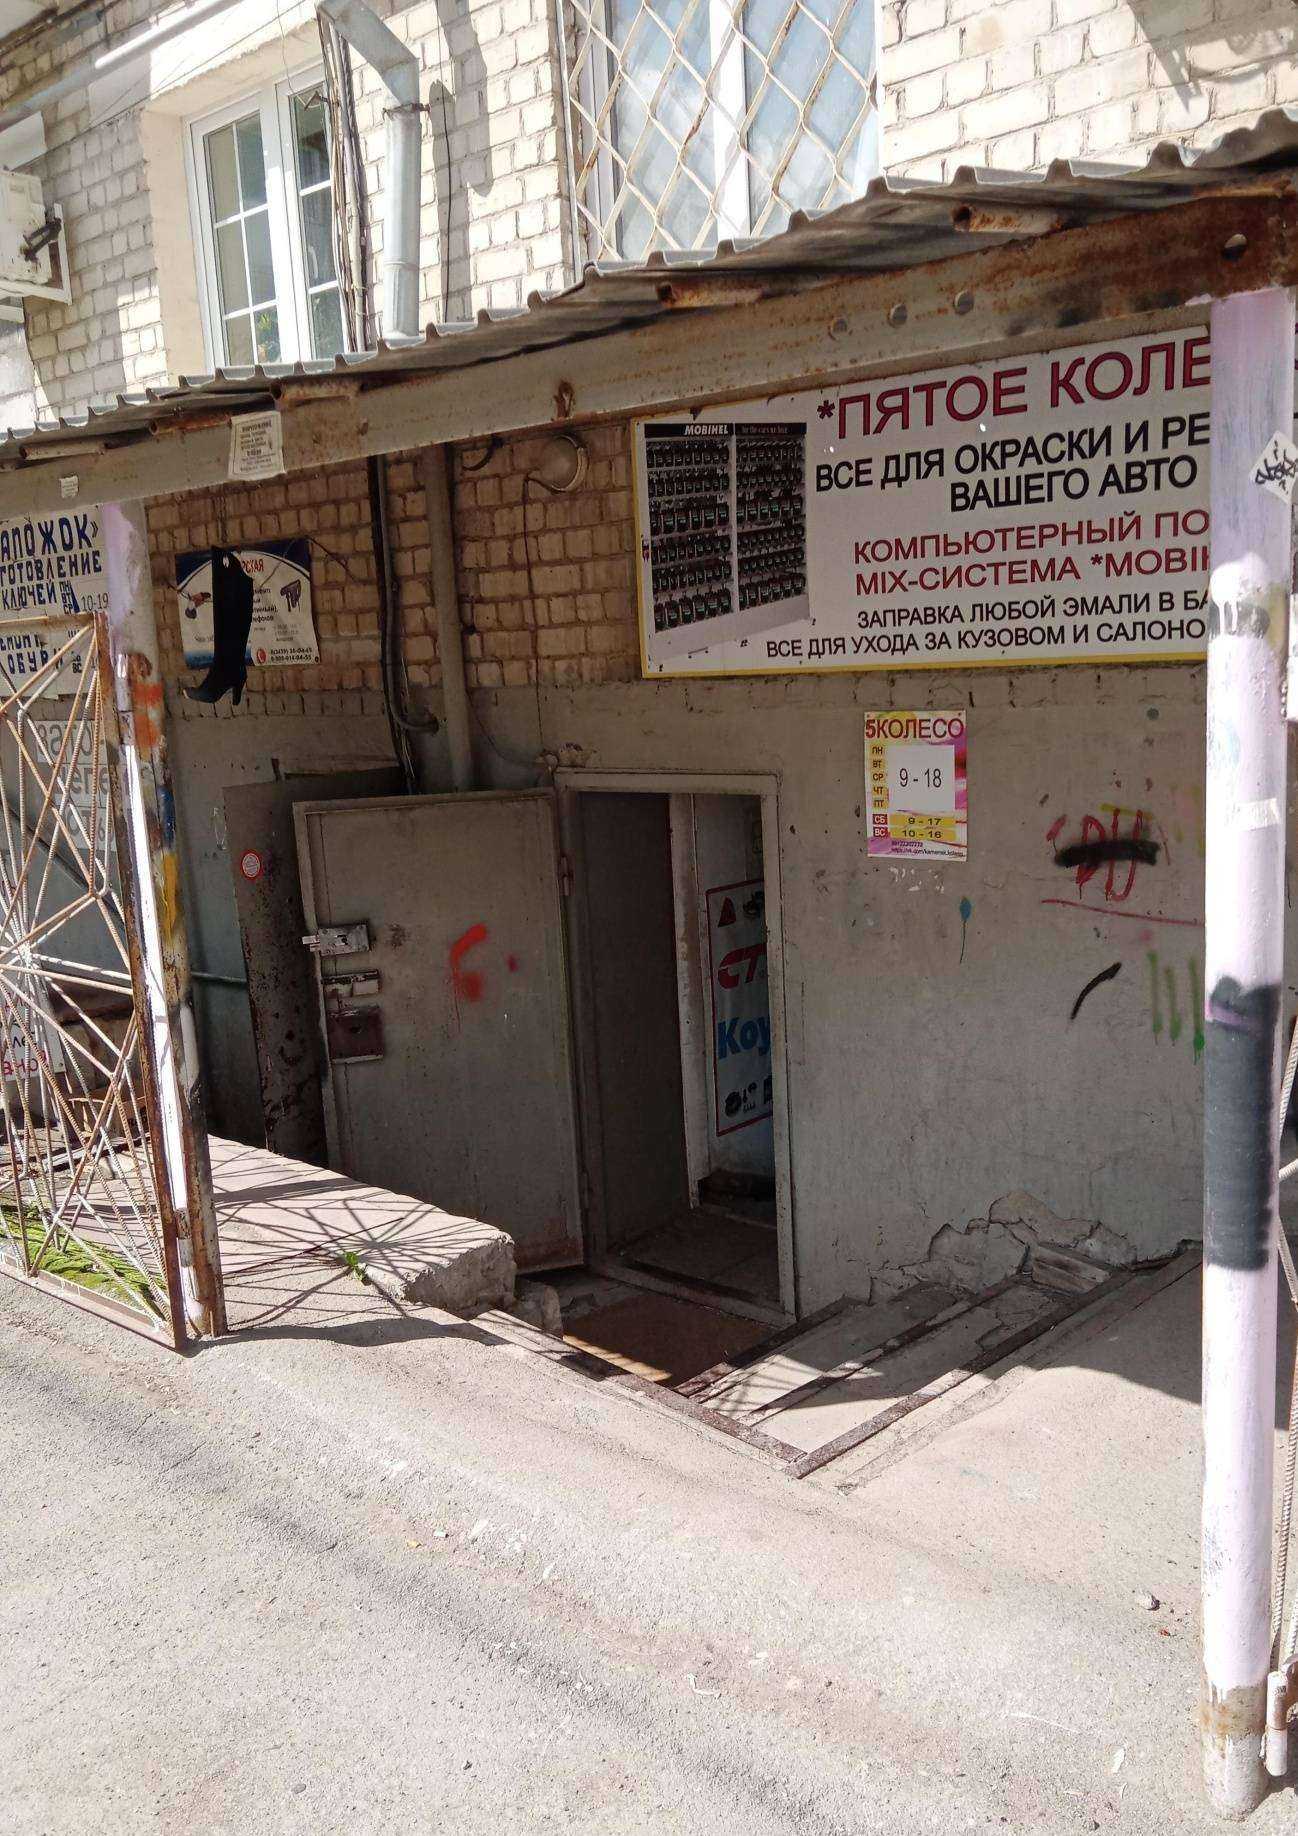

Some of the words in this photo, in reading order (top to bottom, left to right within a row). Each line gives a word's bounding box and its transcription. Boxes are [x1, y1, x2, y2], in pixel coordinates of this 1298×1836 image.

[1050, 336, 1211, 409] КОЛЕ
[684, 423, 728, 436] MOBIHEL
[816, 457, 873, 492] ВСЕ
[881, 448, 945, 491] ДЛЯ
[954, 424, 1112, 475] ОКРАСКИ
[1125, 420, 1149, 445] И
[1162, 411, 1211, 449] РЕ
[950, 467, 1090, 512] ВАШЕГО
[1098, 453, 1198, 497] АВТО
[854, 509, 1142, 564] КОМПЬЮТЕРНЫЙ
[1155, 508, 1210, 537] ПО
[2, 579, 57, 610] КЛЮЧЕЙ
[857, 605, 965, 630] ЗАПРАВКА
[969, 594, 1057, 623] ЛЮБОЙ
[1063, 592, 1151, 617] ЭМАЛИ
[1159, 591, 1175, 611] В
[767, 639, 803, 659] ВСЕ
[808, 637, 847, 660] ДЛЯ
[853, 632, 919, 656] УХОДА
[925, 632, 952, 650] ЗА
[957, 626, 1067, 651] КУЗОВОМ
[1073, 625, 1089, 644] И
[1096, 618, 1206, 642] САЛОНО
[865, 718, 965, 739] 5КОЛЕСО
[872, 746, 883, 754] ПН
[872, 760, 882, 768] ВТ
[872, 773, 884, 781] СР
[899, 768, 909, 788] 9
[924, 768, 943, 788] 18
[873, 787, 884, 795] ЧТ
[873, 799, 884, 808] ПТ
[874, 815, 886, 824] СБ
[927, 818, 942, 826] 17
[874, 829, 886, 837] ВС
[902, 830, 916, 838] 10
[928, 831, 942, 839] 16
